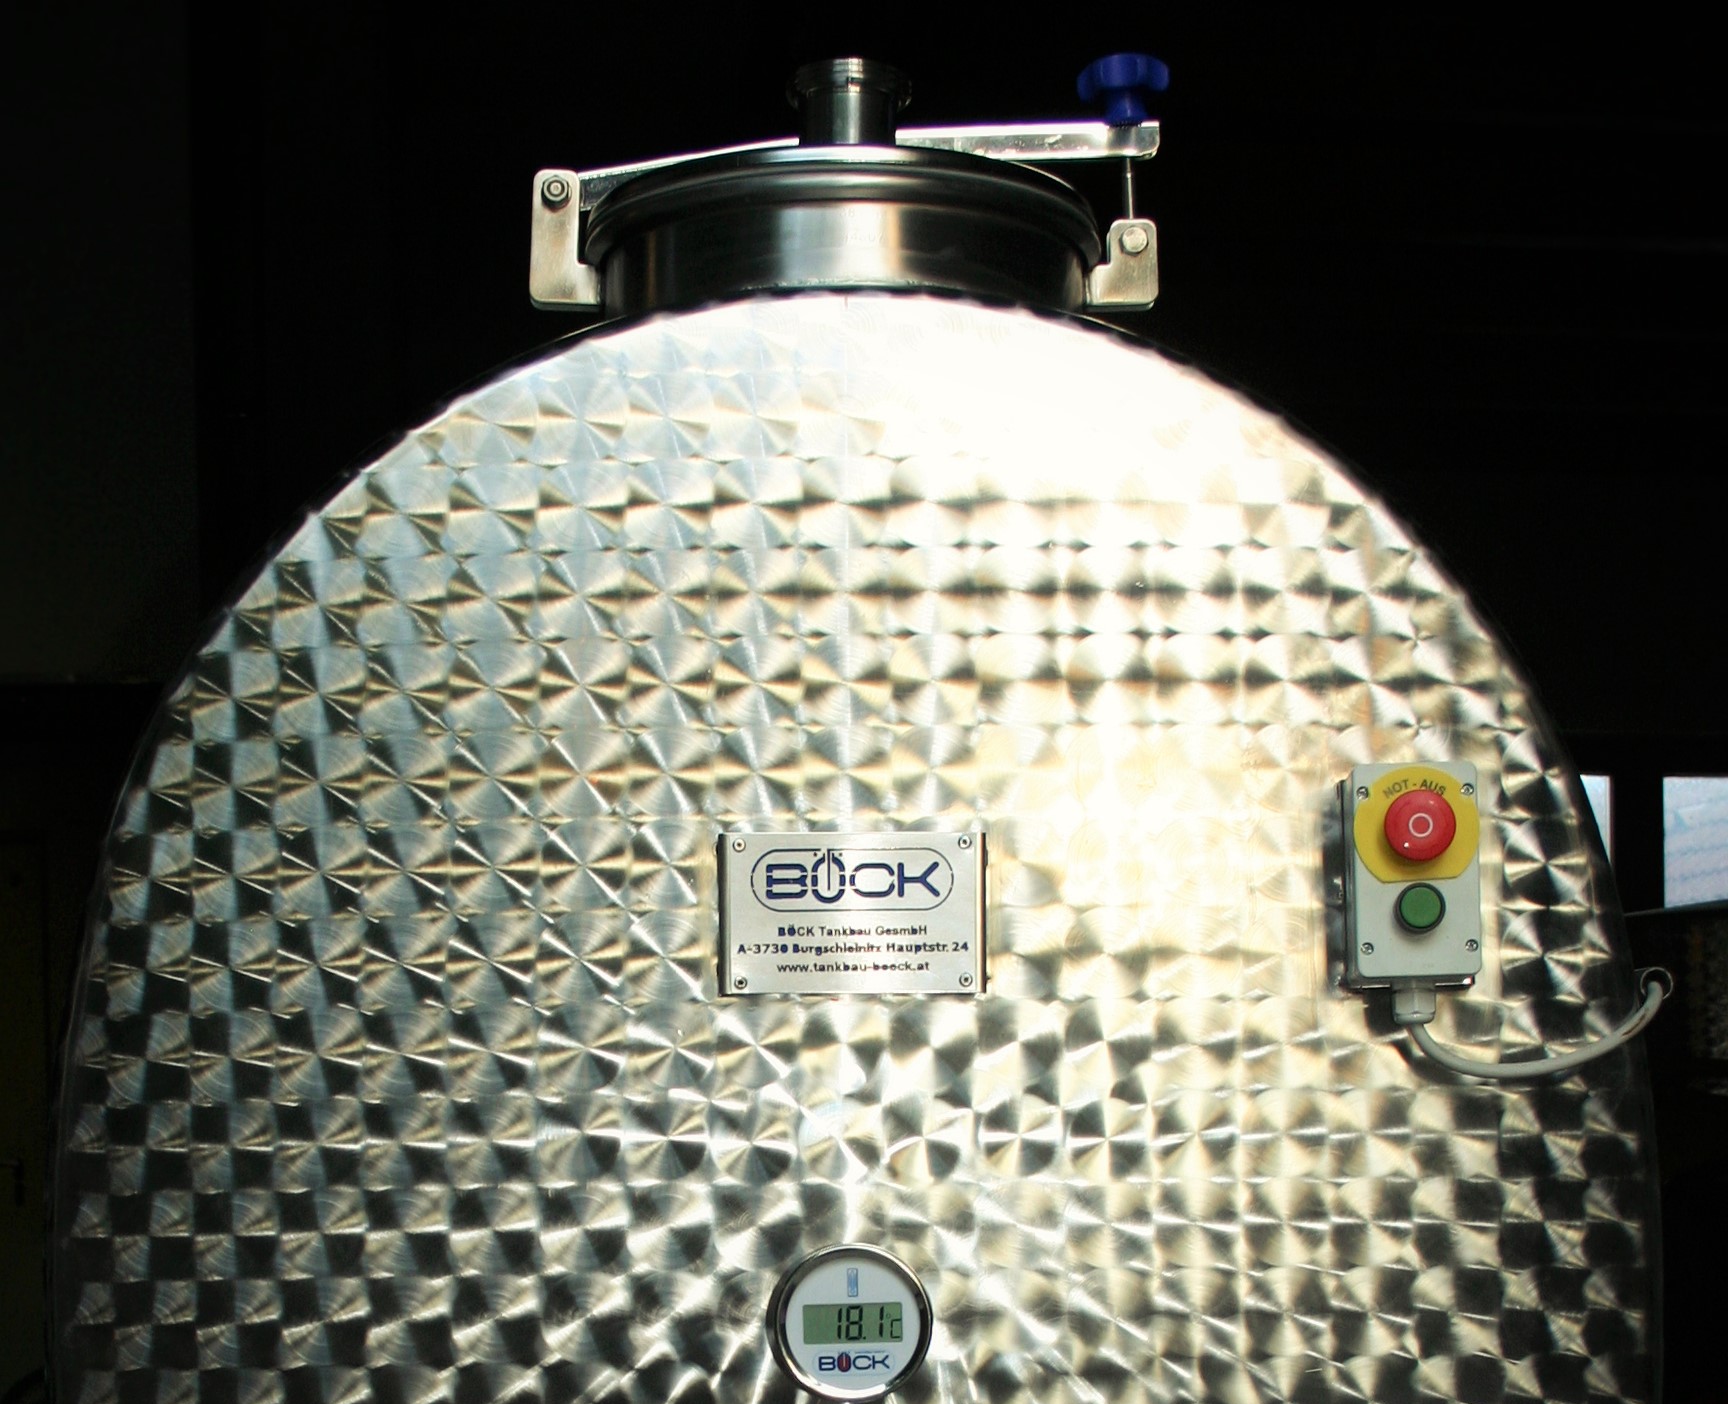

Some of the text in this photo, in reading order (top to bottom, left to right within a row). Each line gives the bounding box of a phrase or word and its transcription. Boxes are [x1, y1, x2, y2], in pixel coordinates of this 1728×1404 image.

[1382, 779, 1409, 799] NOT
[1420, 779, 1446, 796] AUS
[766, 849, 940, 904] BÖCK
[777, 923, 927, 937] BÖCK Tankbau GesmbH
[737, 941, 969, 957] A-3730 Burgschleinitz Hauptstr. 24
[776, 961, 930, 973] www.tankbau-boeck.at
